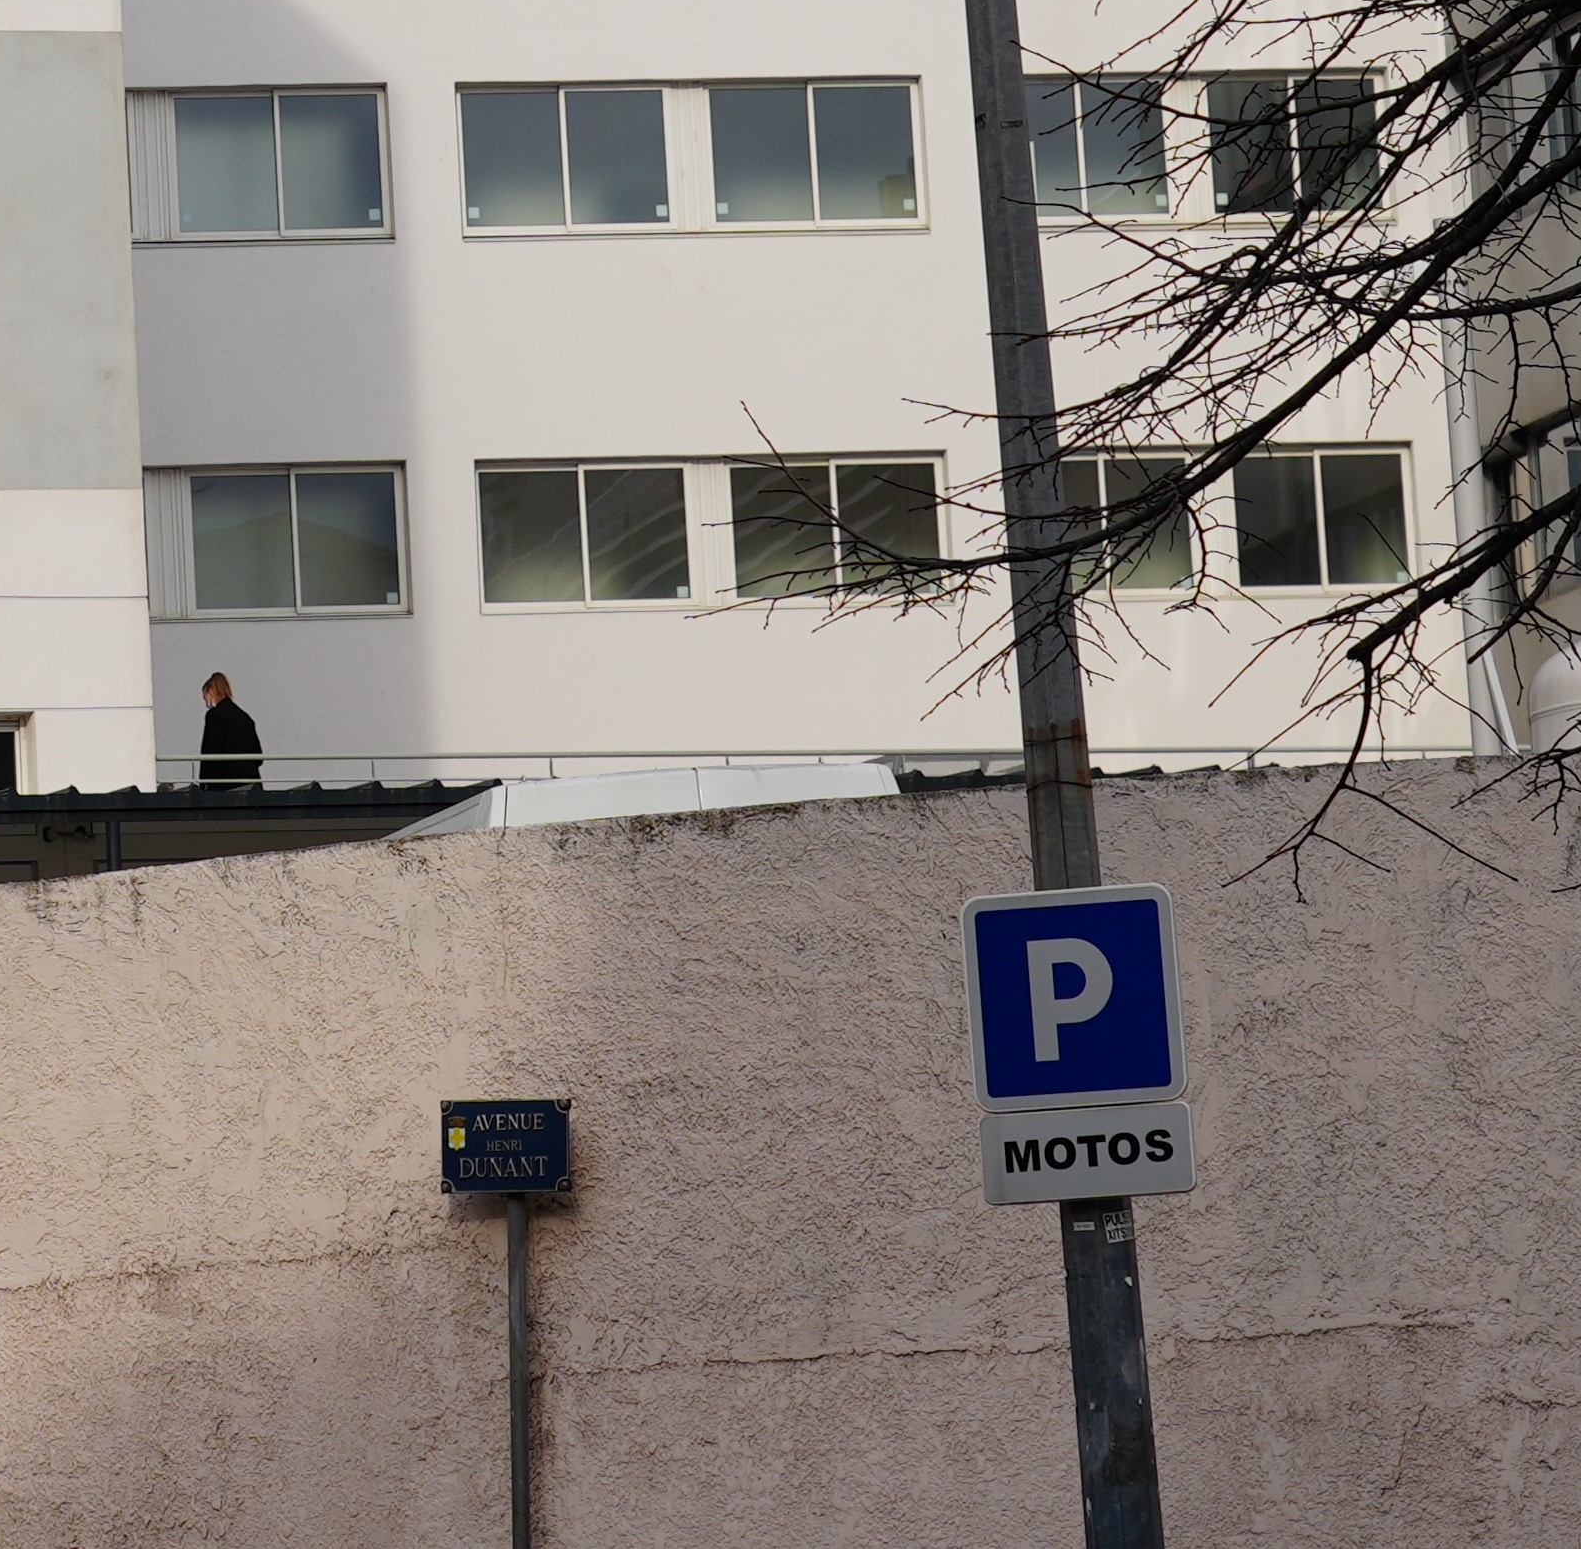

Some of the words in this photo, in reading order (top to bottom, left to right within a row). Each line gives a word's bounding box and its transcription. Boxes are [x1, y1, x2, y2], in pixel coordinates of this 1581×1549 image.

[1026, 937, 1114, 1062] P
[471, 1112, 546, 1132] AVENUE
[486, 1139, 523, 1152] HENRI
[1003, 1127, 1175, 1174] MOTOS
[458, 1155, 549, 1179] DUNANT
